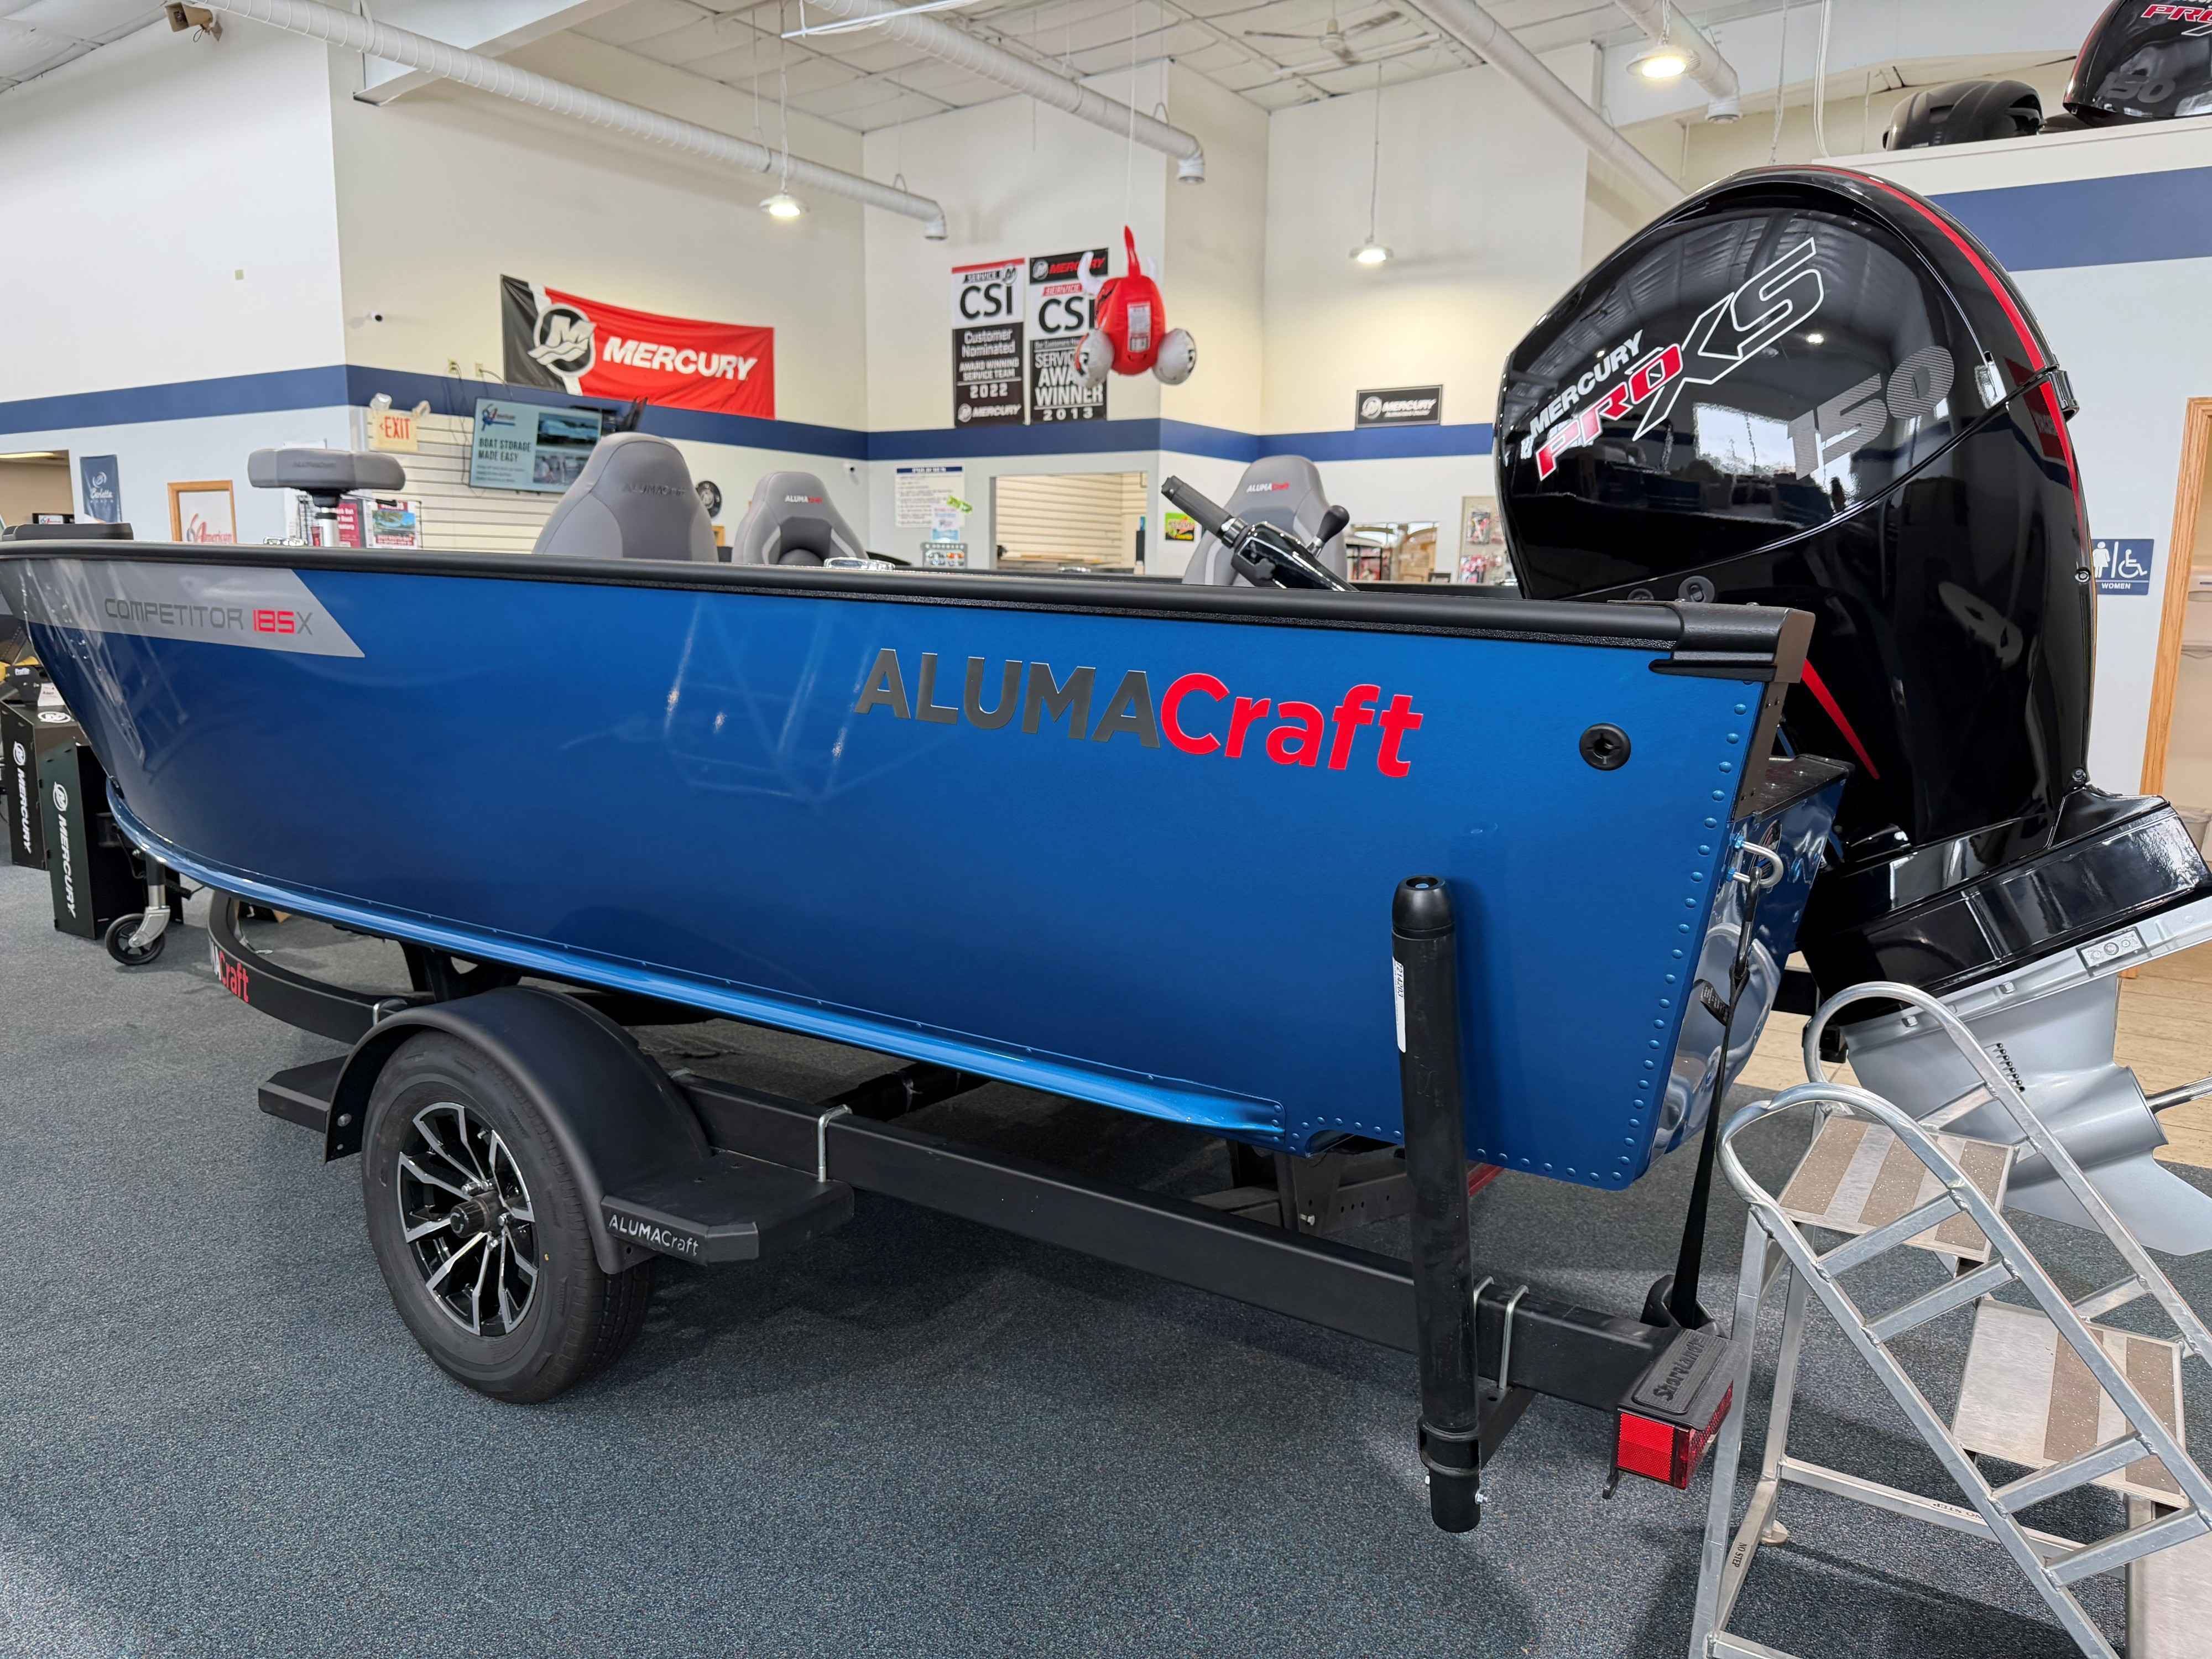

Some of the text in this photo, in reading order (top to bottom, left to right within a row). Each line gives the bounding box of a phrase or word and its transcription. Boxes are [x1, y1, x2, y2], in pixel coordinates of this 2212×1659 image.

[964, 328, 1013, 344] Customer
[602, 336, 758, 380] MERCURY
[962, 340, 1016, 357] Nominated
[1035, 351, 1074, 368] SERVIC
[1536, 236, 1824, 482] PRO XS
[959, 357, 1020, 372] AWARD WINNING
[963, 368, 1015, 381] SERVICE TEAM
[1038, 367, 1078, 387] AWA
[1530, 329, 1643, 437] MERCURY
[970, 382, 1008, 399] 2022
[1035, 382, 1103, 406] WINNER
[972, 404, 1021, 418] MERCURY
[1042, 406, 1093, 421] 2013
[1787, 345, 1955, 480] 150
[384, 415, 411, 440] EXIT
[479, 437, 531, 452] BOAT STORAGE
[478, 450, 519, 462] MADE EASY
[104, 598, 244, 630] COMPETITOR
[854, 648, 1423, 778] ALUMACraft
[17, 767, 32, 854] MERCURY
[58, 813, 76, 919] MERCURY
[609, 1214, 699, 1256] ALUMACraft
[1932, 1503, 1962, 1514] STEP
[1731, 1542, 1747, 1568] NO STEP
